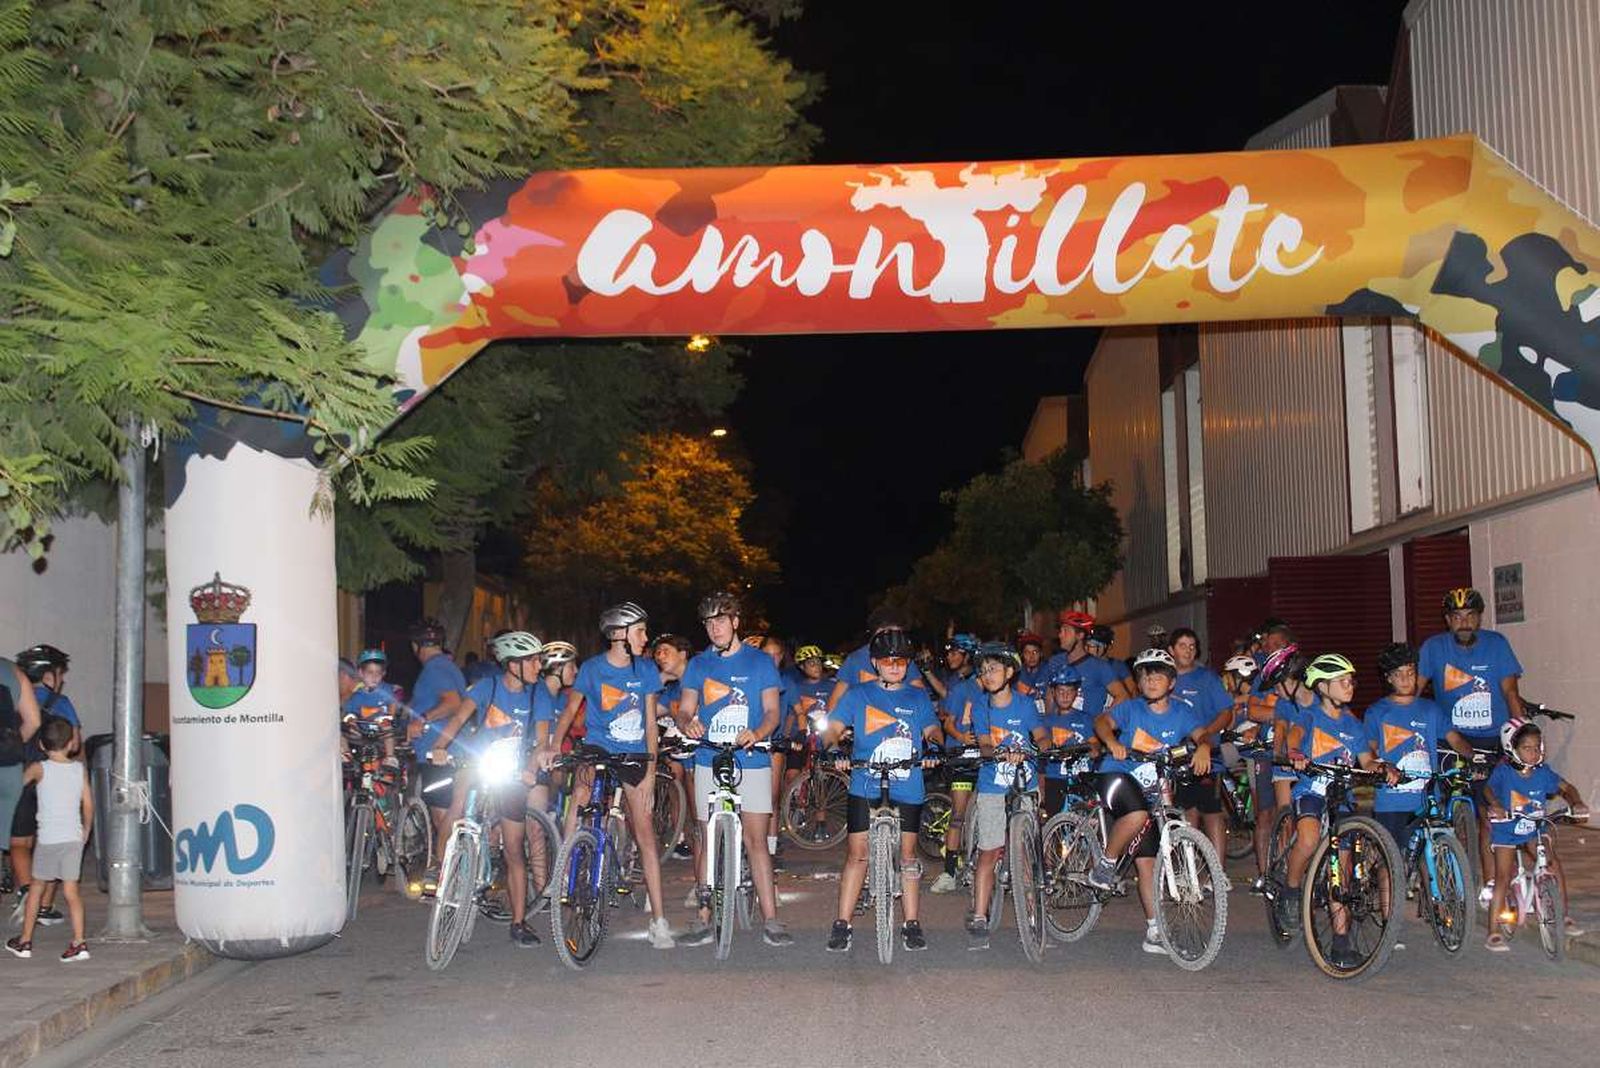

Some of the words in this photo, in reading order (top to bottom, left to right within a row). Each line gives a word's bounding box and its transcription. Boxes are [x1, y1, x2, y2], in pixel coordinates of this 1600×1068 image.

[224, 715, 237, 723] de
[239, 712, 284, 723] Montilla
[1454, 706, 1489, 718] Llena
